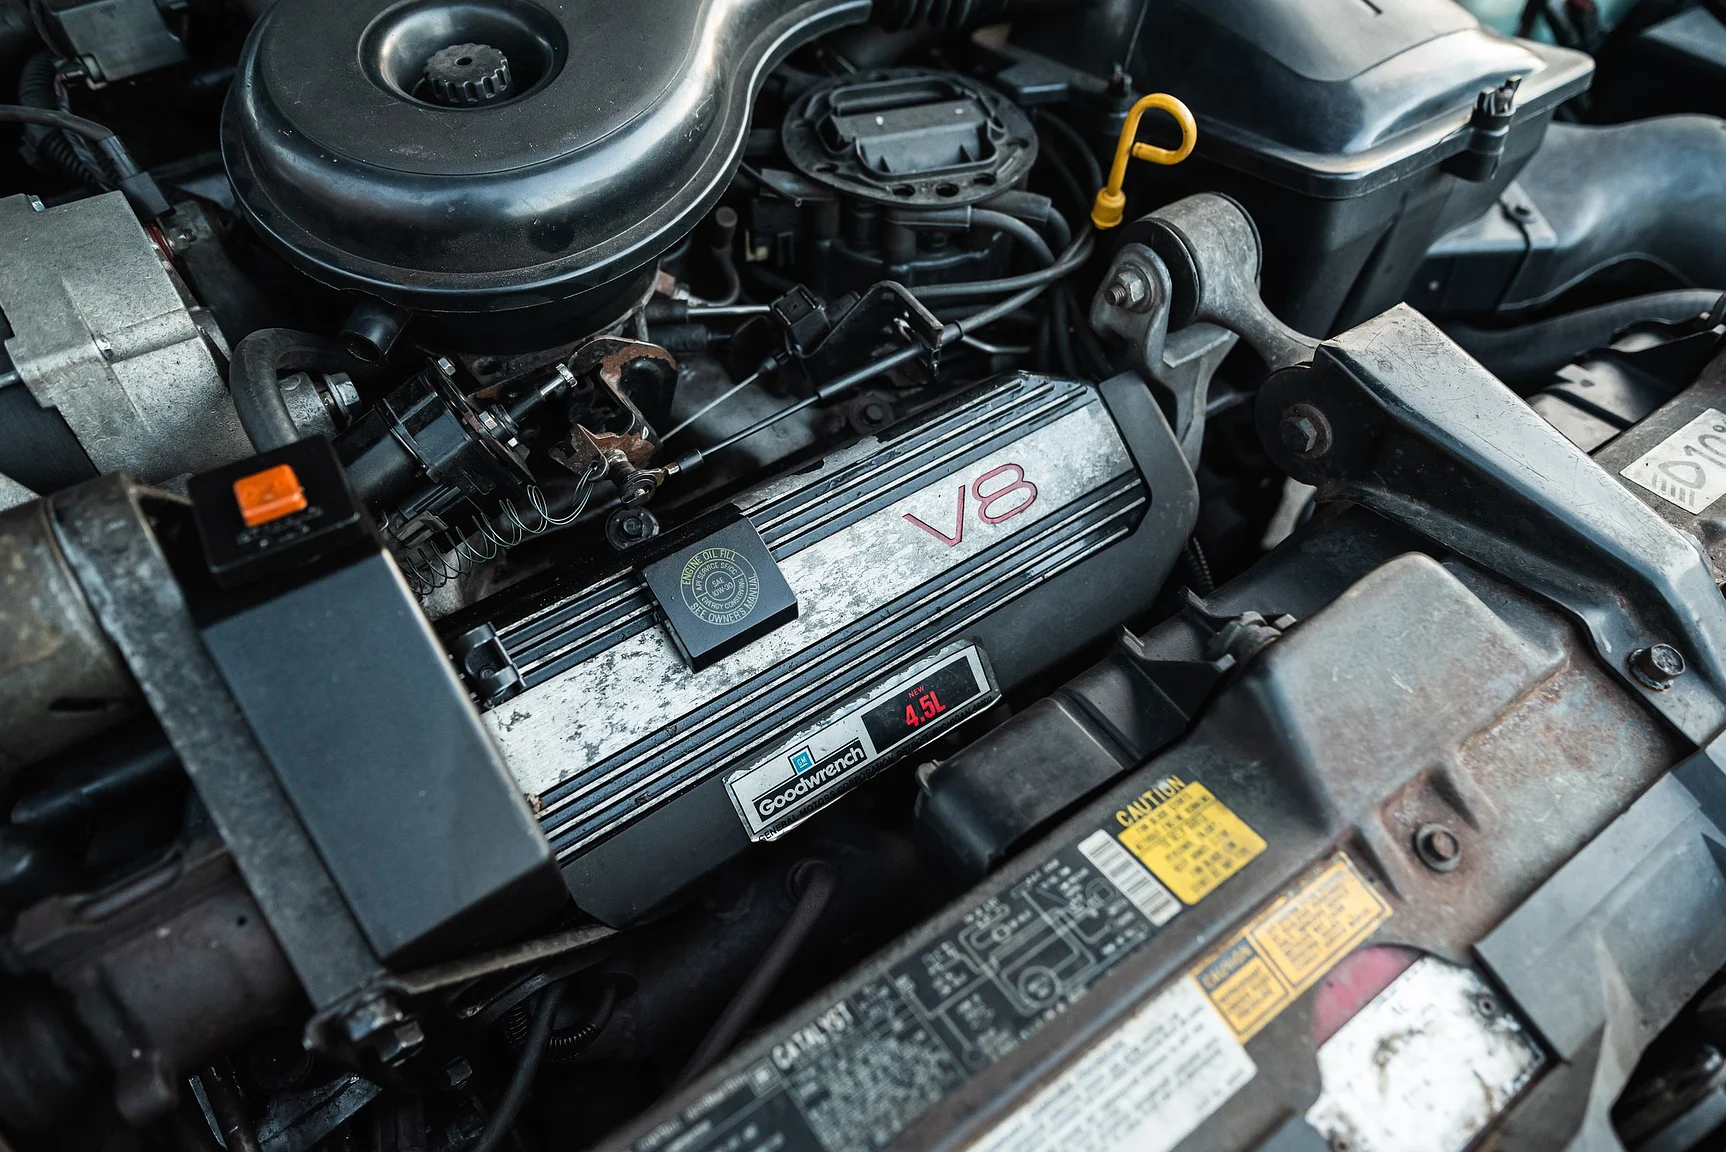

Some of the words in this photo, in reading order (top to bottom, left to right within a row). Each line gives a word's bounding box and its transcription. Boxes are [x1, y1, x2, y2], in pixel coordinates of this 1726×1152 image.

[902, 463, 1038, 547] V8
[682, 555, 703, 585] ENGINE
[702, 550, 718, 560] OIL
[719, 549, 736, 562] FILL
[695, 579, 703, 591] API
[697, 562, 720, 580] SERVICE
[711, 576, 726, 588] SAE
[690, 602, 708, 619] SEE
[708, 607, 747, 623] OWNER'S
[743, 573, 758, 610] MANUAL
[701, 596, 724, 610] ENERGY
[724, 578, 745, 610] CONSERVING
[711, 581, 734, 598] 10W-30
[905, 691, 946, 727] 4.5L
[908, 685, 925, 699] NEW
[758, 745, 866, 817] Goodwrench
[758, 814, 798, 841] GENERAL
[799, 790, 837, 816] MOTORS
[1116, 775, 1186, 827] CAUTION
